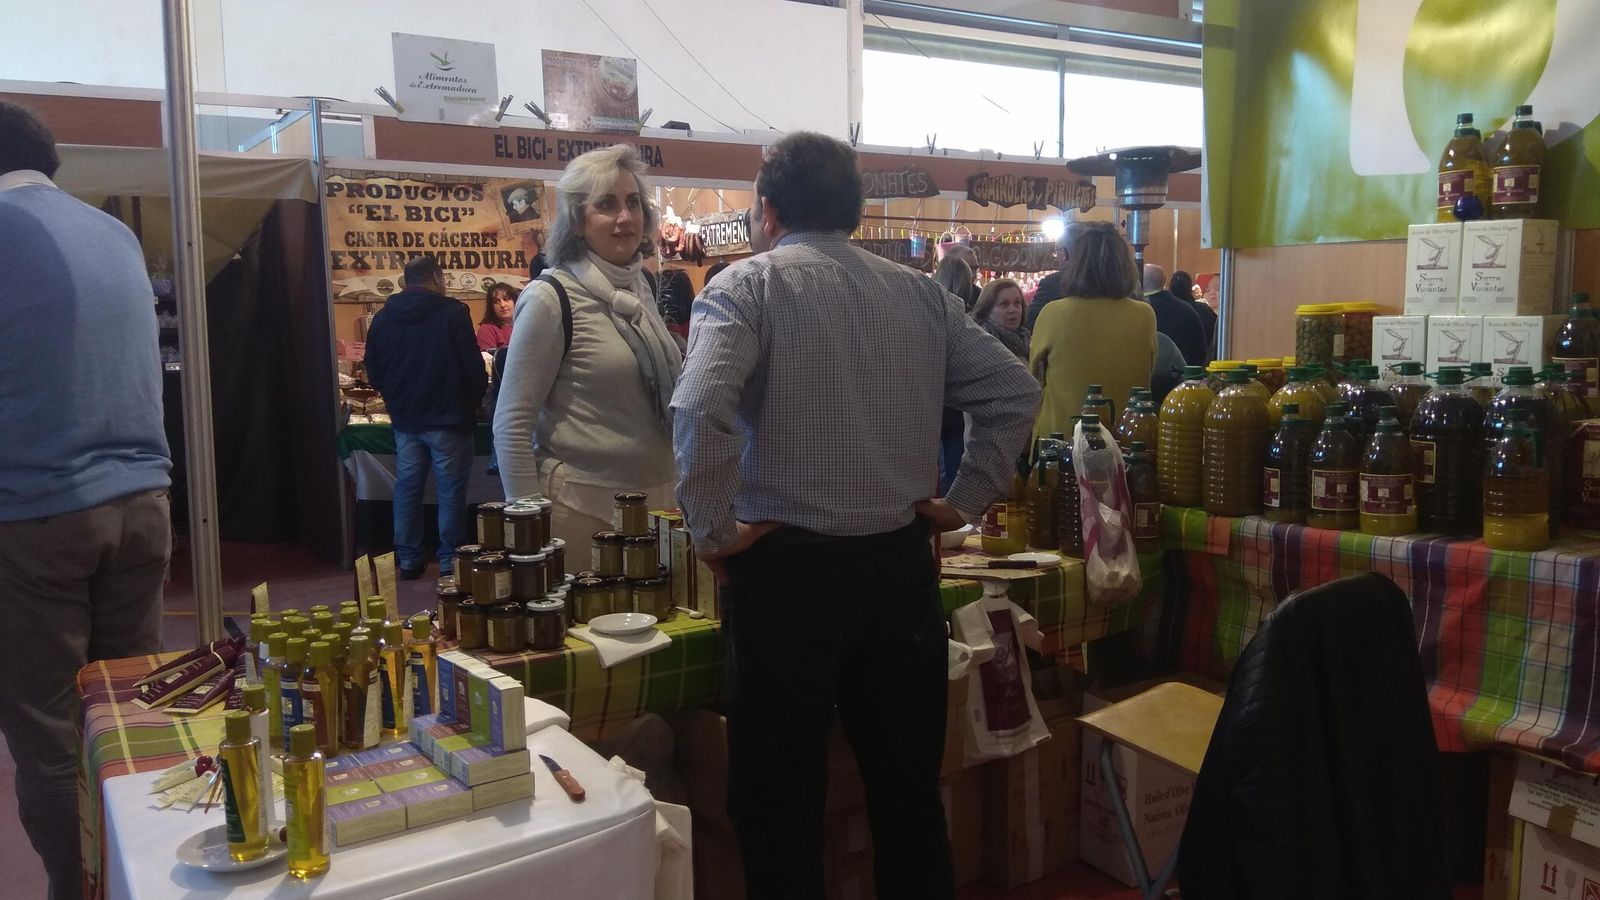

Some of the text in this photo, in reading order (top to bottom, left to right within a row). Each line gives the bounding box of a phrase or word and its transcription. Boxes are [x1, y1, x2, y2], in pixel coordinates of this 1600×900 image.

[419, 72, 467, 83] Alimentos
[417, 81, 478, 94] Extremadura
[494, 134, 514, 159] EL
[557, 138, 664, 168] EXTRRA
[326, 182, 485, 202] PRODUCTOS
[344, 227, 498, 248] CASAR DE CÁCERES
[1419, 272, 1444, 283] Sierra
[1475, 271, 1501, 281] Sierra
